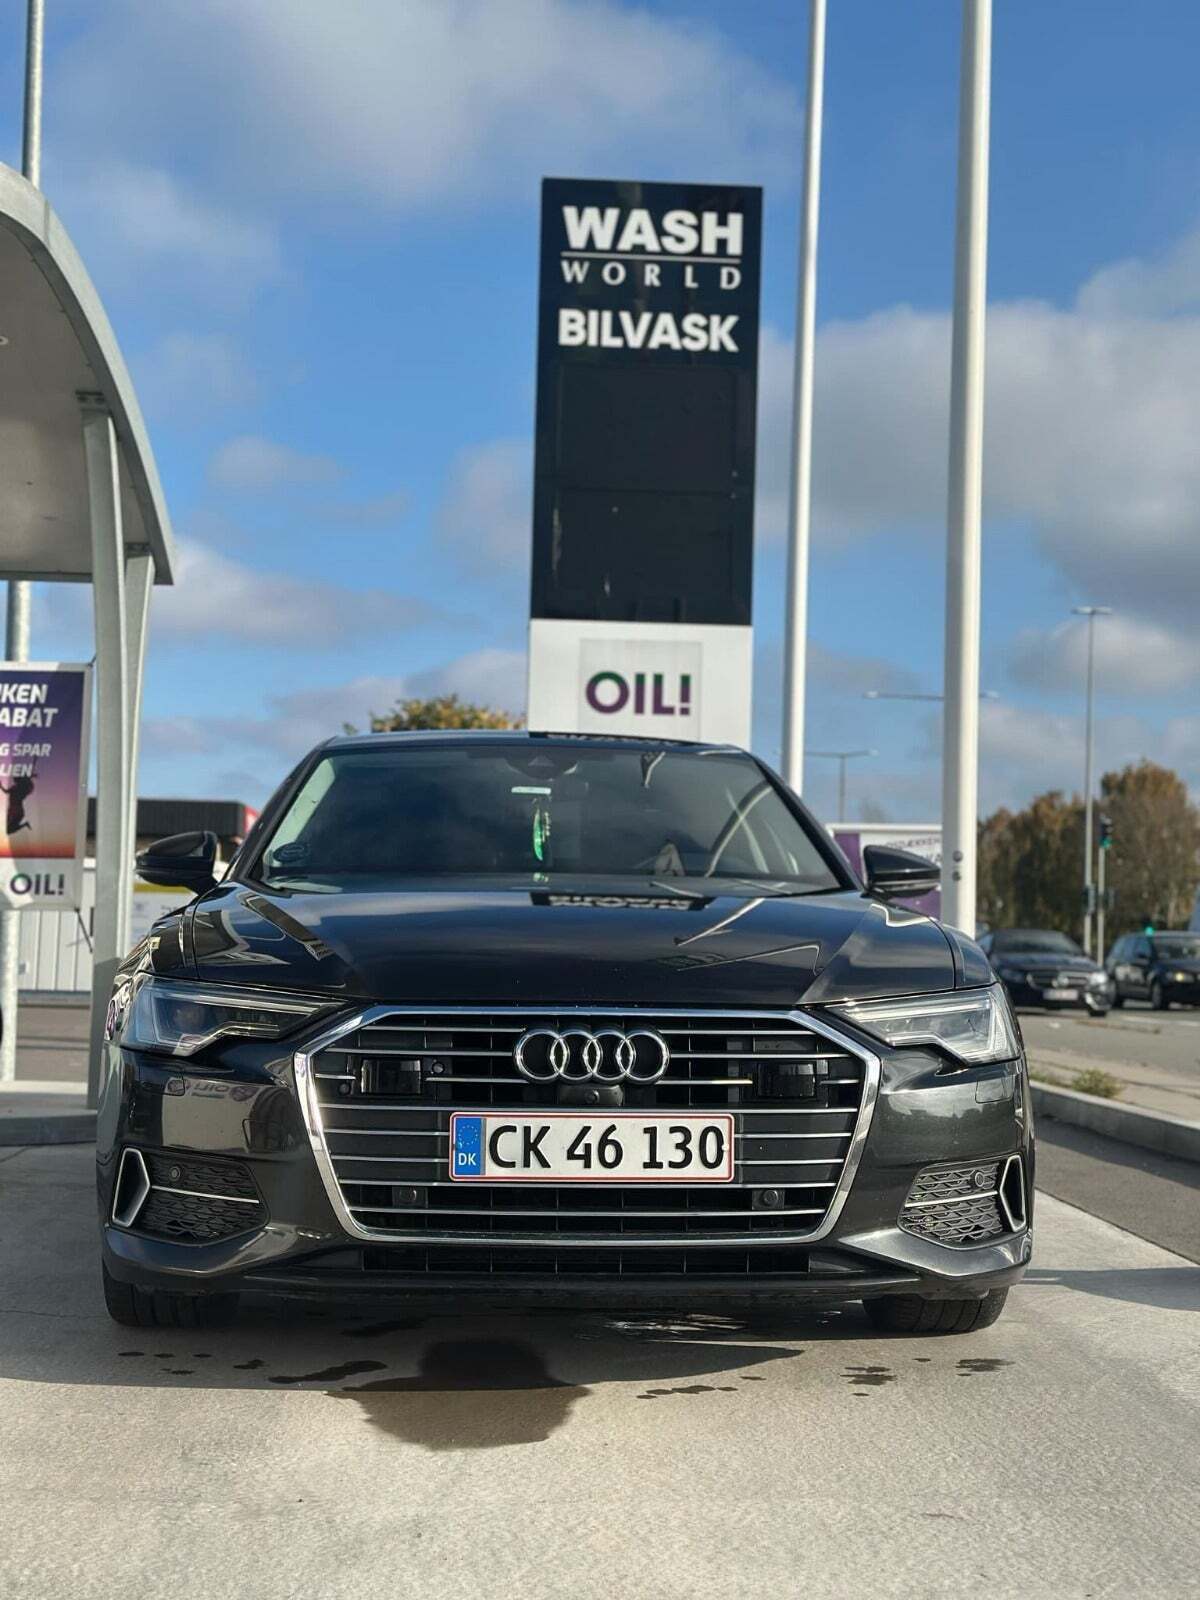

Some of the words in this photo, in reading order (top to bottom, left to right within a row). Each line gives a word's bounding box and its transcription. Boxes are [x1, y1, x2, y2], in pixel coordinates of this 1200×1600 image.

[562, 205, 744, 256] WASH
[560, 260, 742, 290] WORLD
[558, 308, 739, 353] BILVASK
[0, 683, 48, 704] KEN
[585, 670, 691, 715] OIL!
[13, 743, 52, 757] SPAR
[10, 872, 65, 896] OIL!
[458, 1152, 477, 1166] DK
[489, 1125, 551, 1169] CK
[567, 1124, 623, 1169] 46
[643, 1125, 725, 1169] 130
